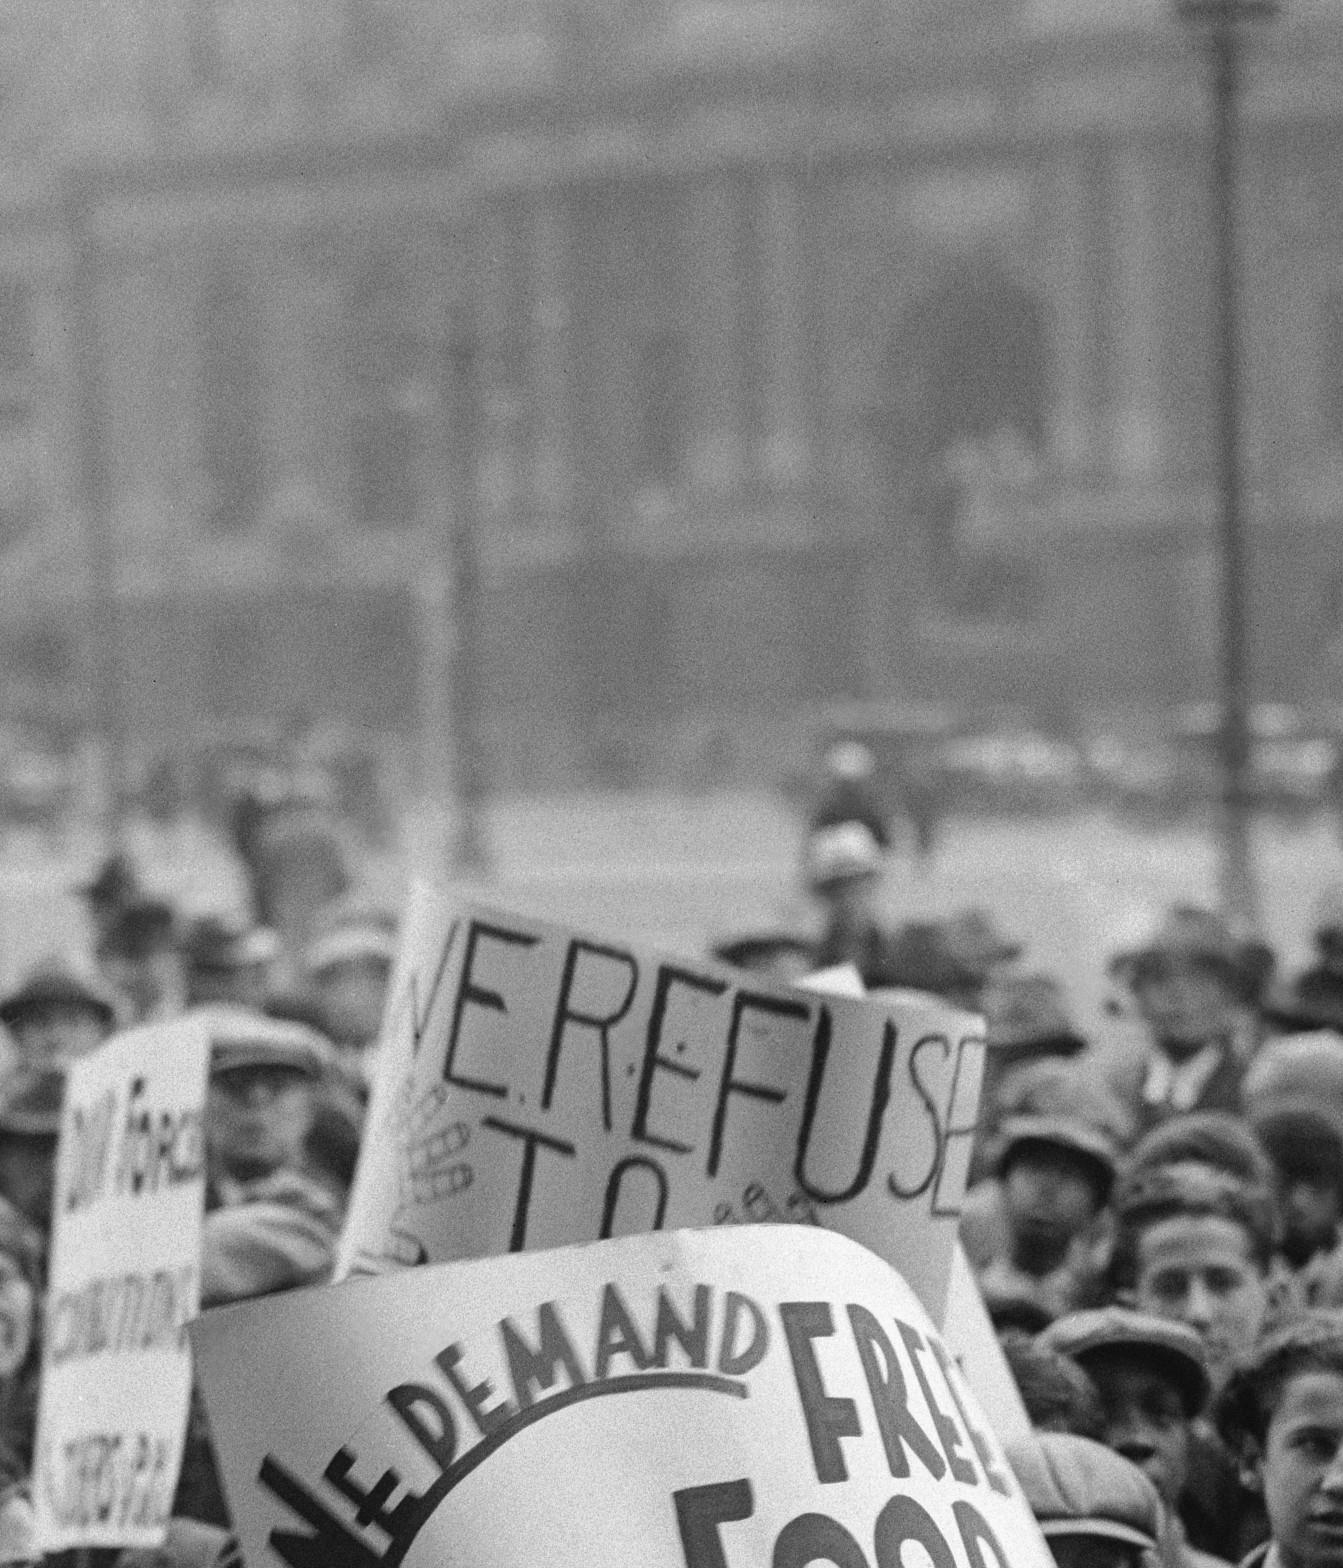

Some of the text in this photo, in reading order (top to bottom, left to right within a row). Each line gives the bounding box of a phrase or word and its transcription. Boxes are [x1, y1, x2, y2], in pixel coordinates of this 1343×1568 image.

[482, 1115, 667, 1254] TO
[389, 1280, 768, 1477] DEMAND
[778, 1301, 1013, 1499] FREE
